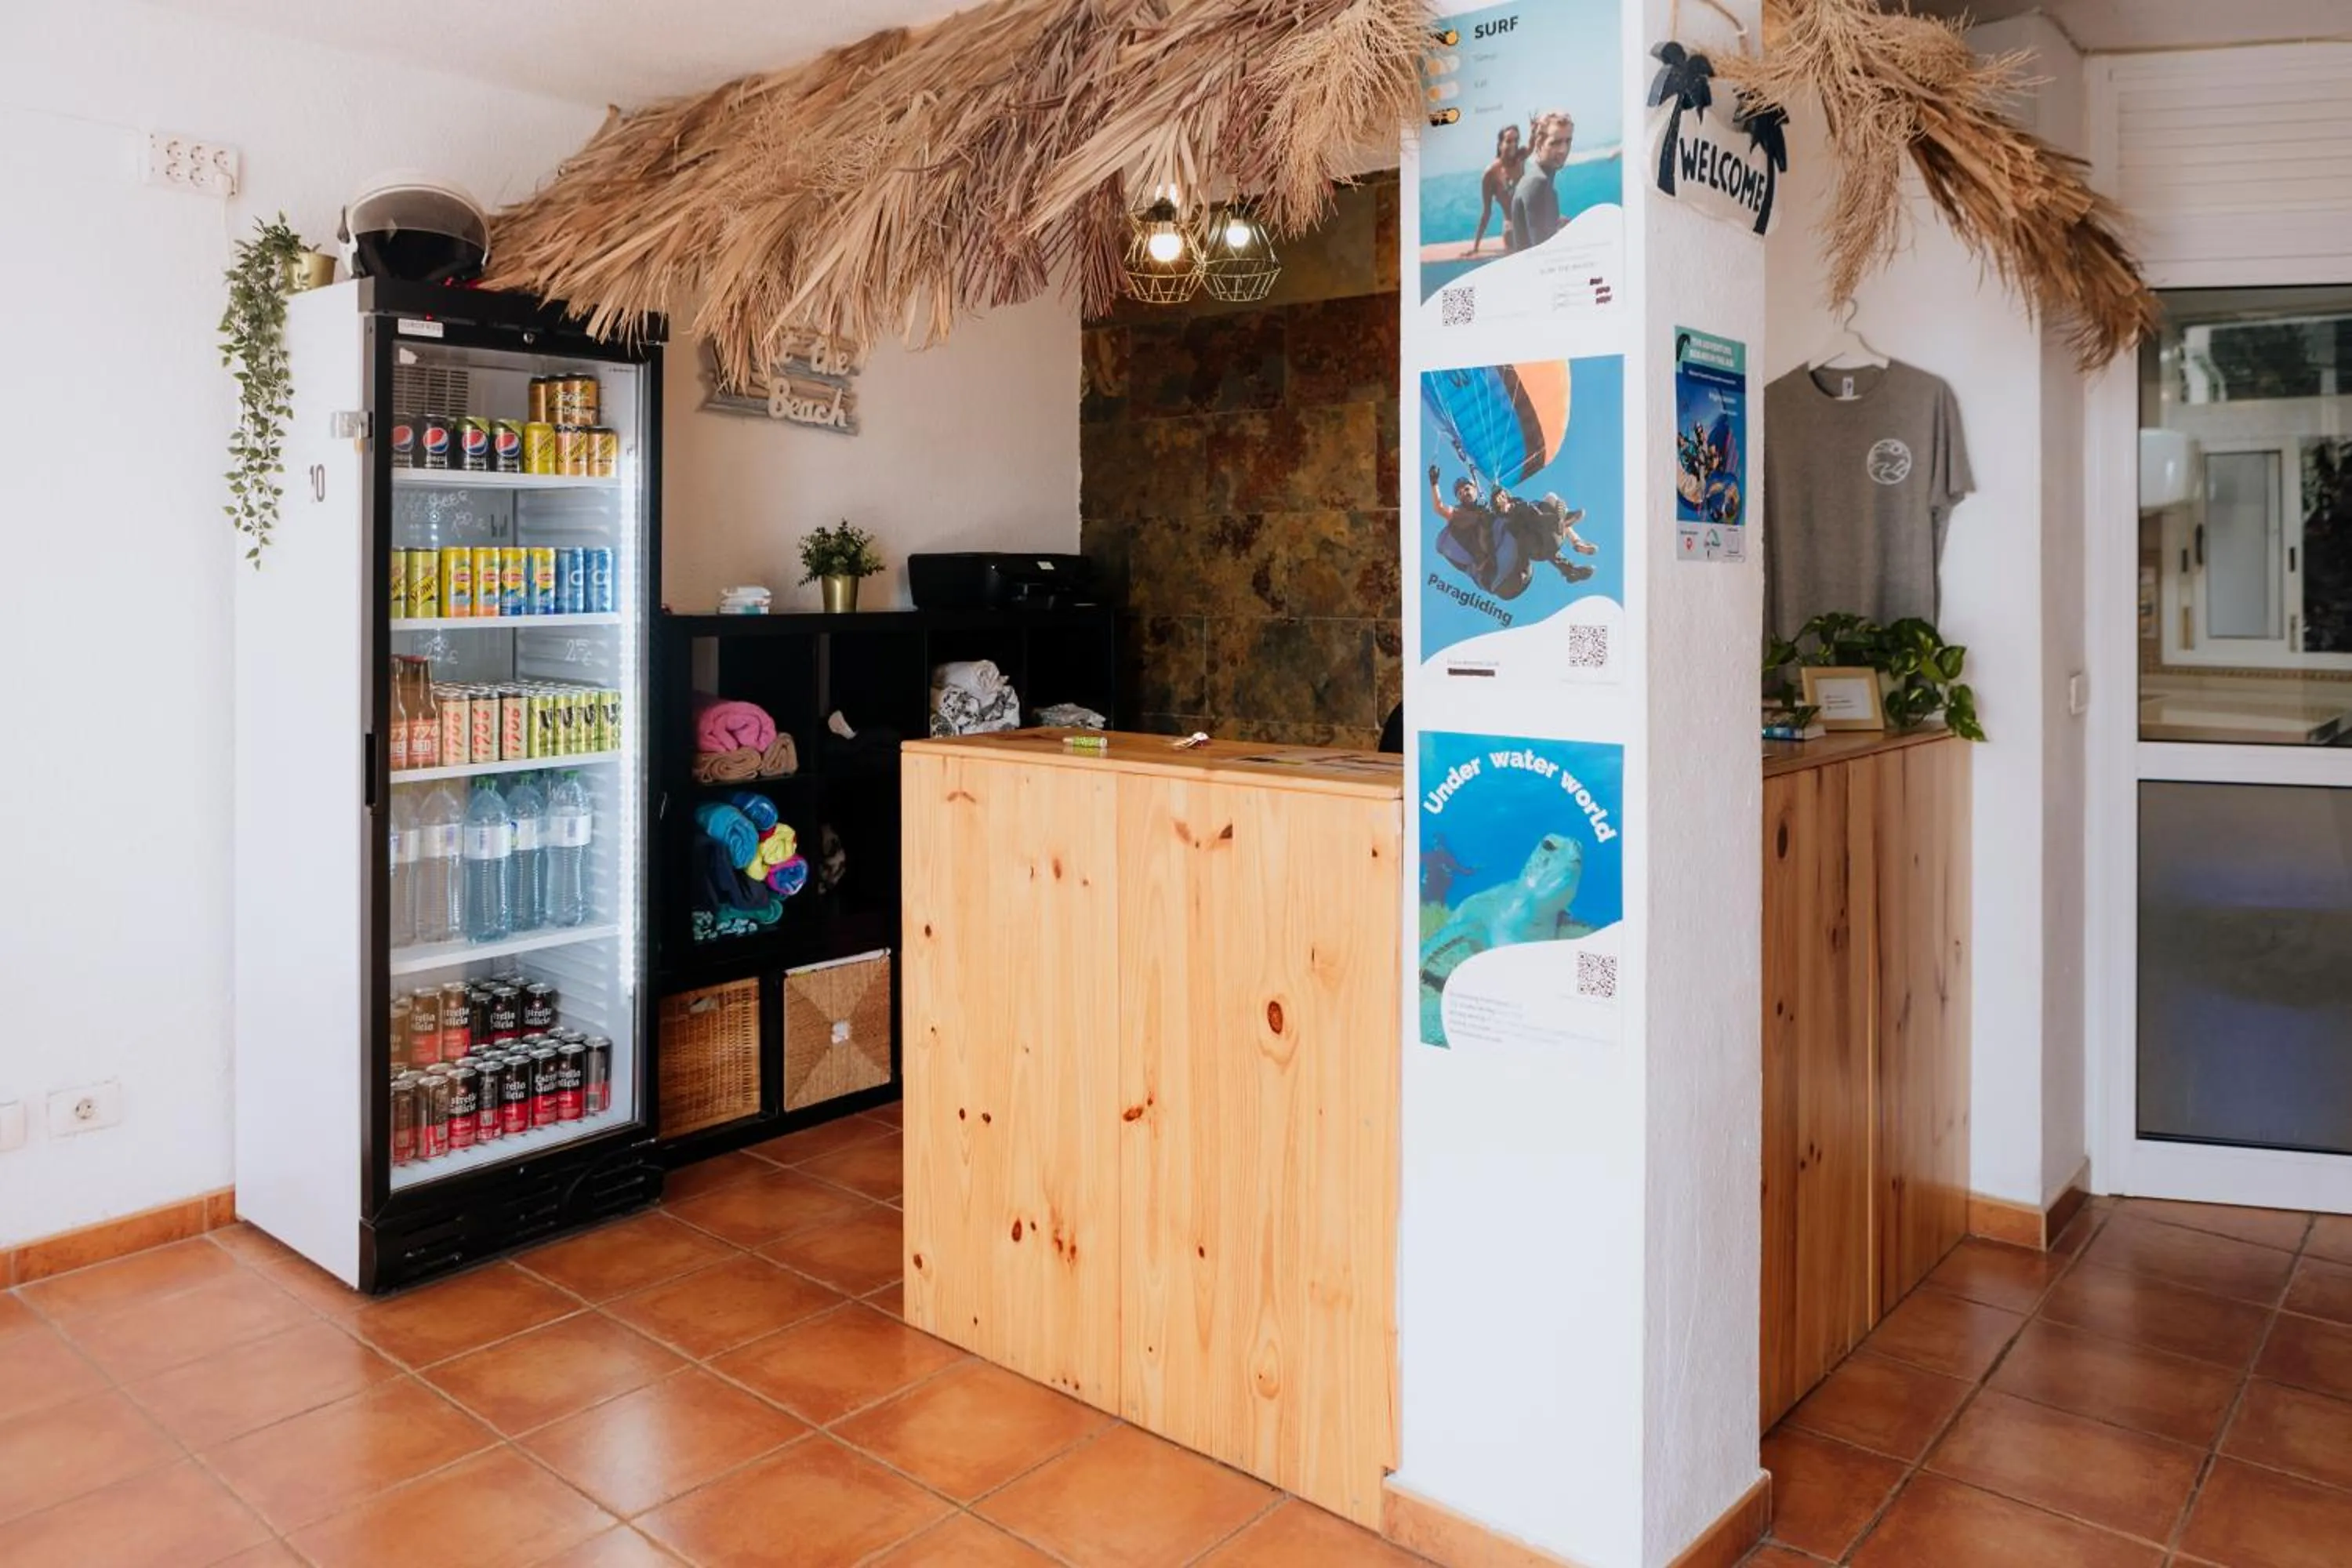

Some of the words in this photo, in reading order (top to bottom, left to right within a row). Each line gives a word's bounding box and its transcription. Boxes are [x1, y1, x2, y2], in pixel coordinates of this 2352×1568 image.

[1475, 15, 1519, 39] SURF
[1679, 137, 1766, 213] WELCOME
[768, 377, 848, 427] Beach
[1428, 573, 1513, 627] Paragliding
[1423, 757, 1481, 815] Under
[1489, 750, 1559, 779] water
[1560, 771, 1617, 844] world
